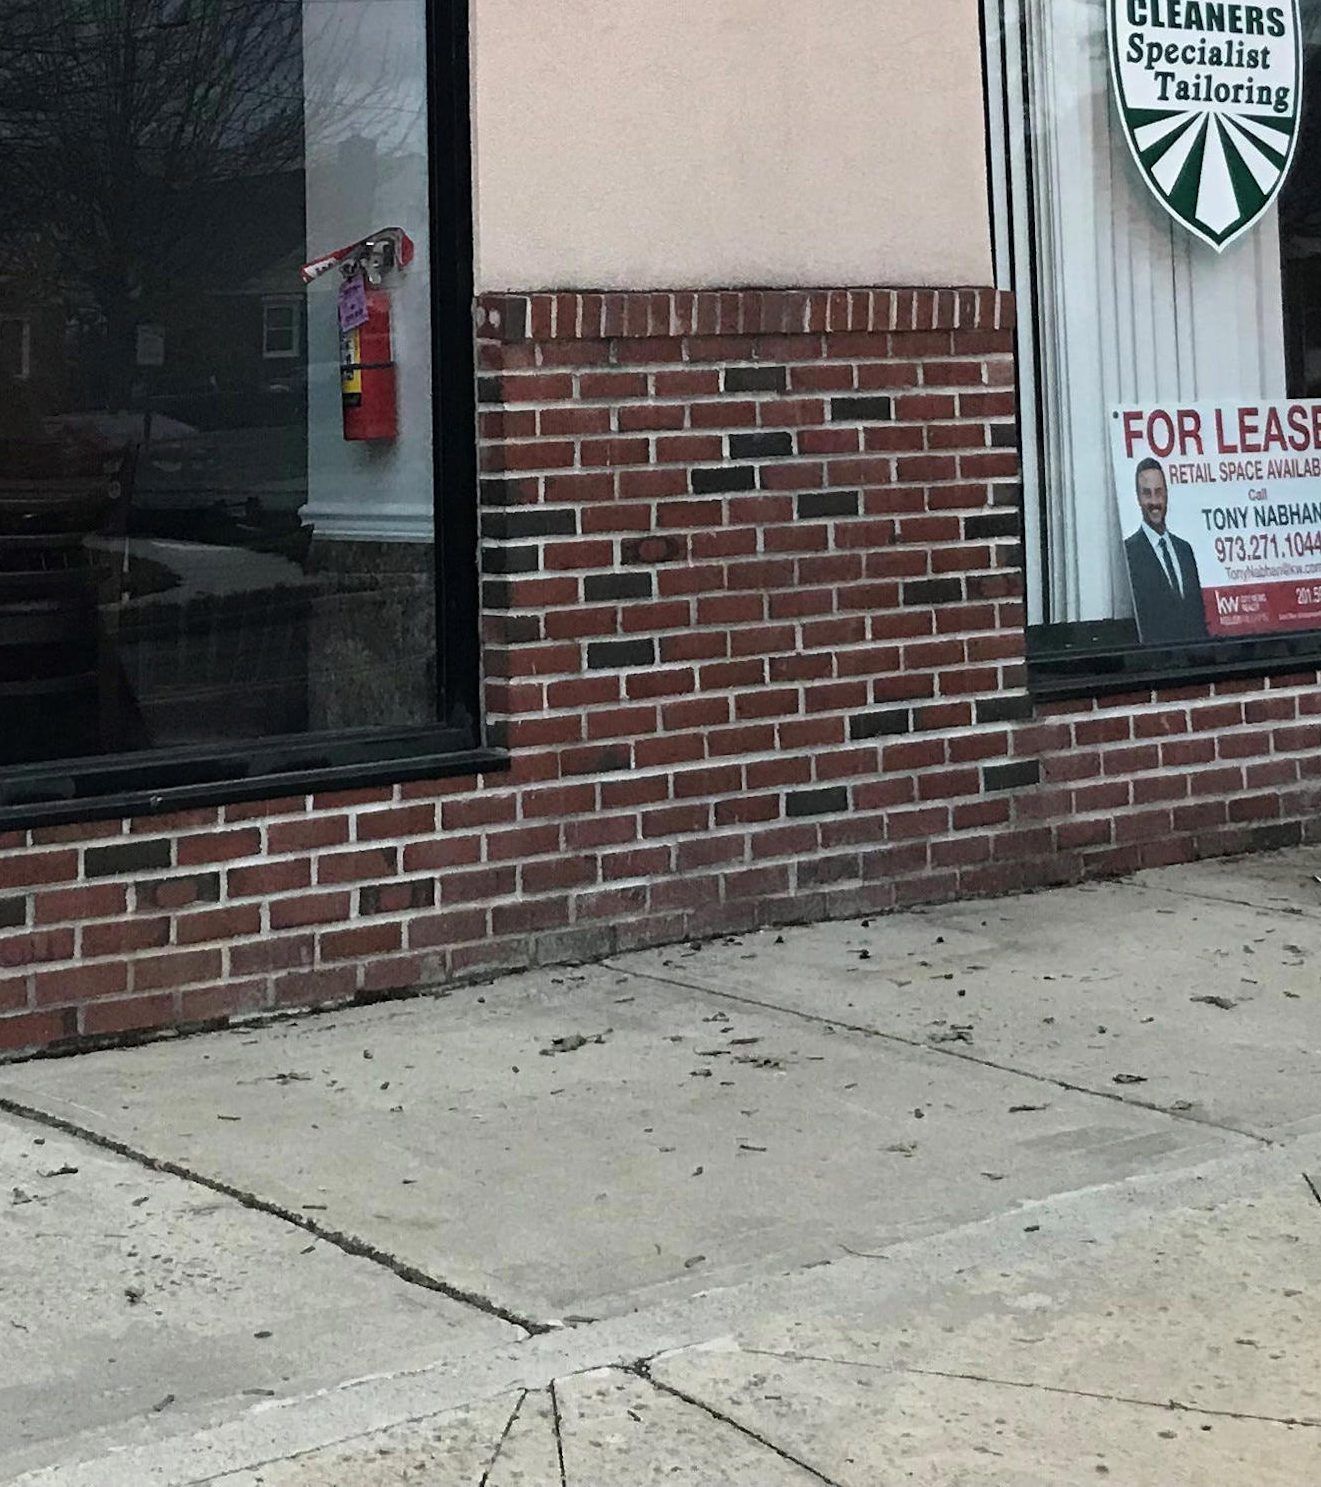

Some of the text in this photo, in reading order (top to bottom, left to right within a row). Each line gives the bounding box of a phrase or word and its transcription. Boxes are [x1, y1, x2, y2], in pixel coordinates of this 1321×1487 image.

[1126, 32, 1271, 70] Specialist
[1154, 71, 1290, 113] Tailoring
[1122, 409, 1204, 459] FOR
[1168, 462, 1217, 485] RETAIL
[1219, 460, 1264, 483] SPACE
[1248, 488, 1267, 502] Call
[1202, 506, 1251, 531] TONY
[1215, 590, 1239, 615] kw
